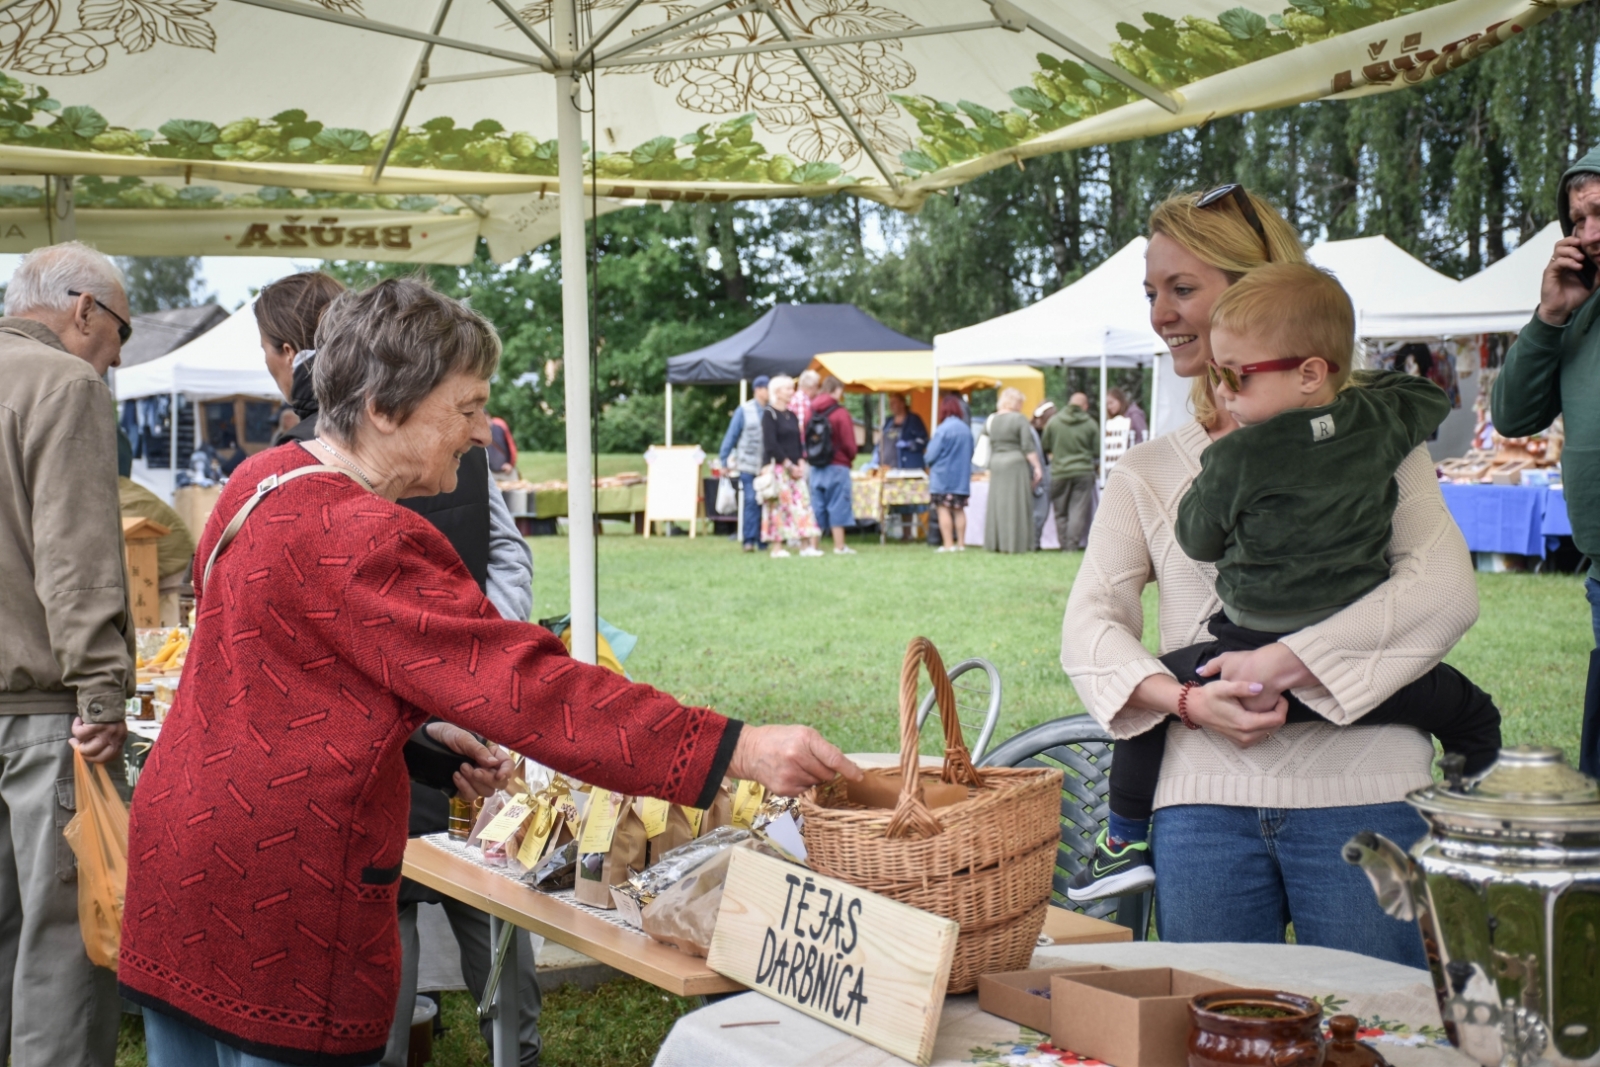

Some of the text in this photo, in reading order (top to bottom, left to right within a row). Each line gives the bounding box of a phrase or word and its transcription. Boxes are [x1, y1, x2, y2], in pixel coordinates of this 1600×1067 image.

[1319, 421, 1329, 437] R
[781, 873, 862, 955] TĒJAS
[755, 926, 868, 1026] DARBNĪCA
